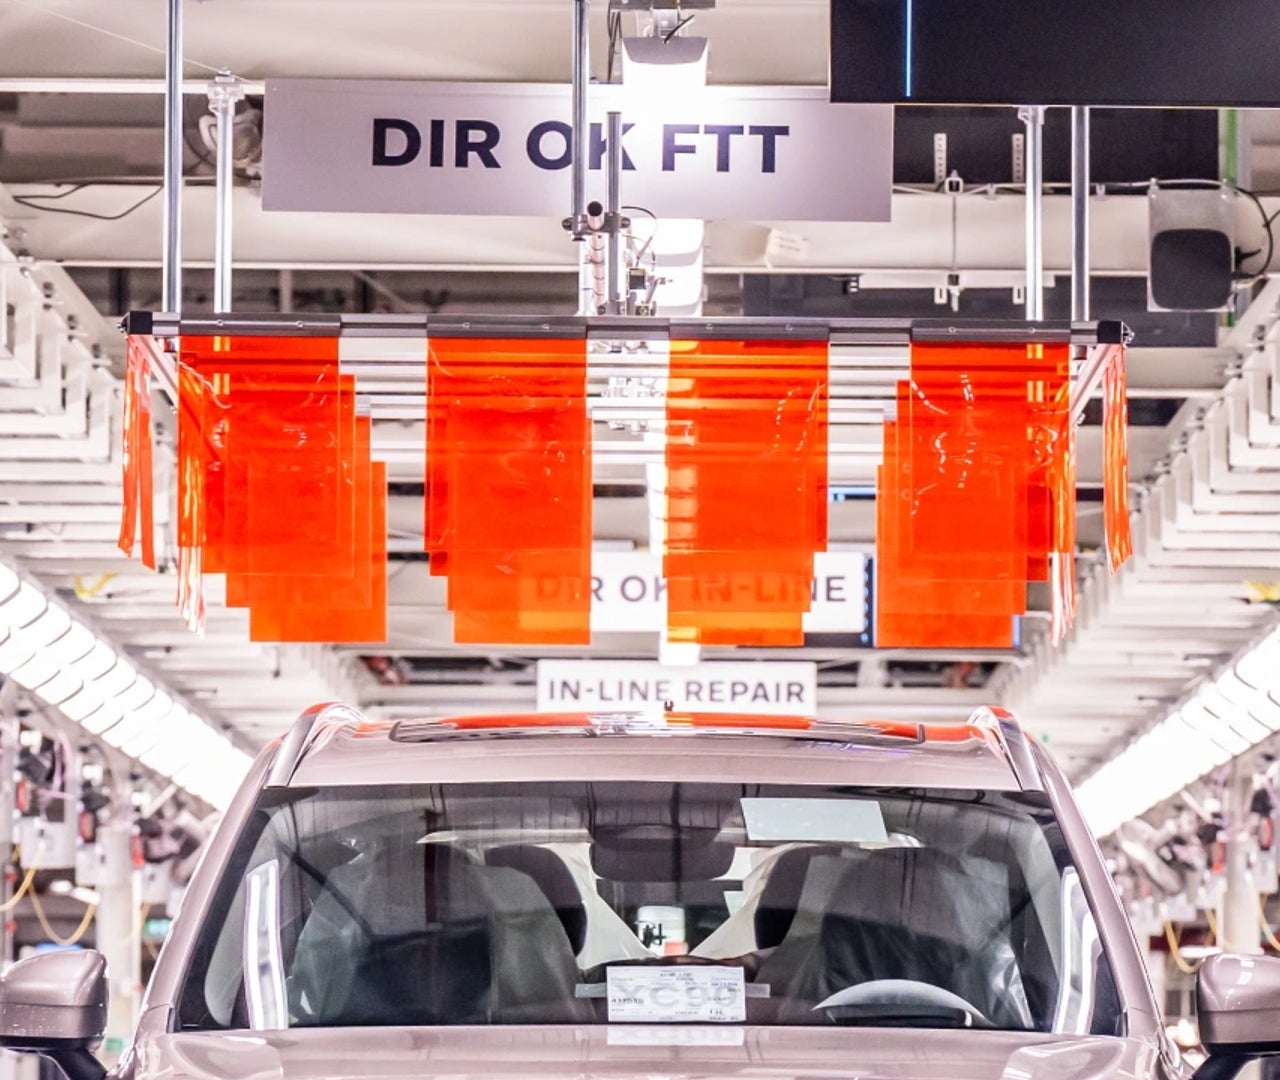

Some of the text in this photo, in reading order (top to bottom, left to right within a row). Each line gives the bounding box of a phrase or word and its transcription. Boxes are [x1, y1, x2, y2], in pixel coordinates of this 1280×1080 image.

[372, 117, 790, 173] DIR OK FTT
[549, 679, 805, 704] IN-LINE REPAIR
